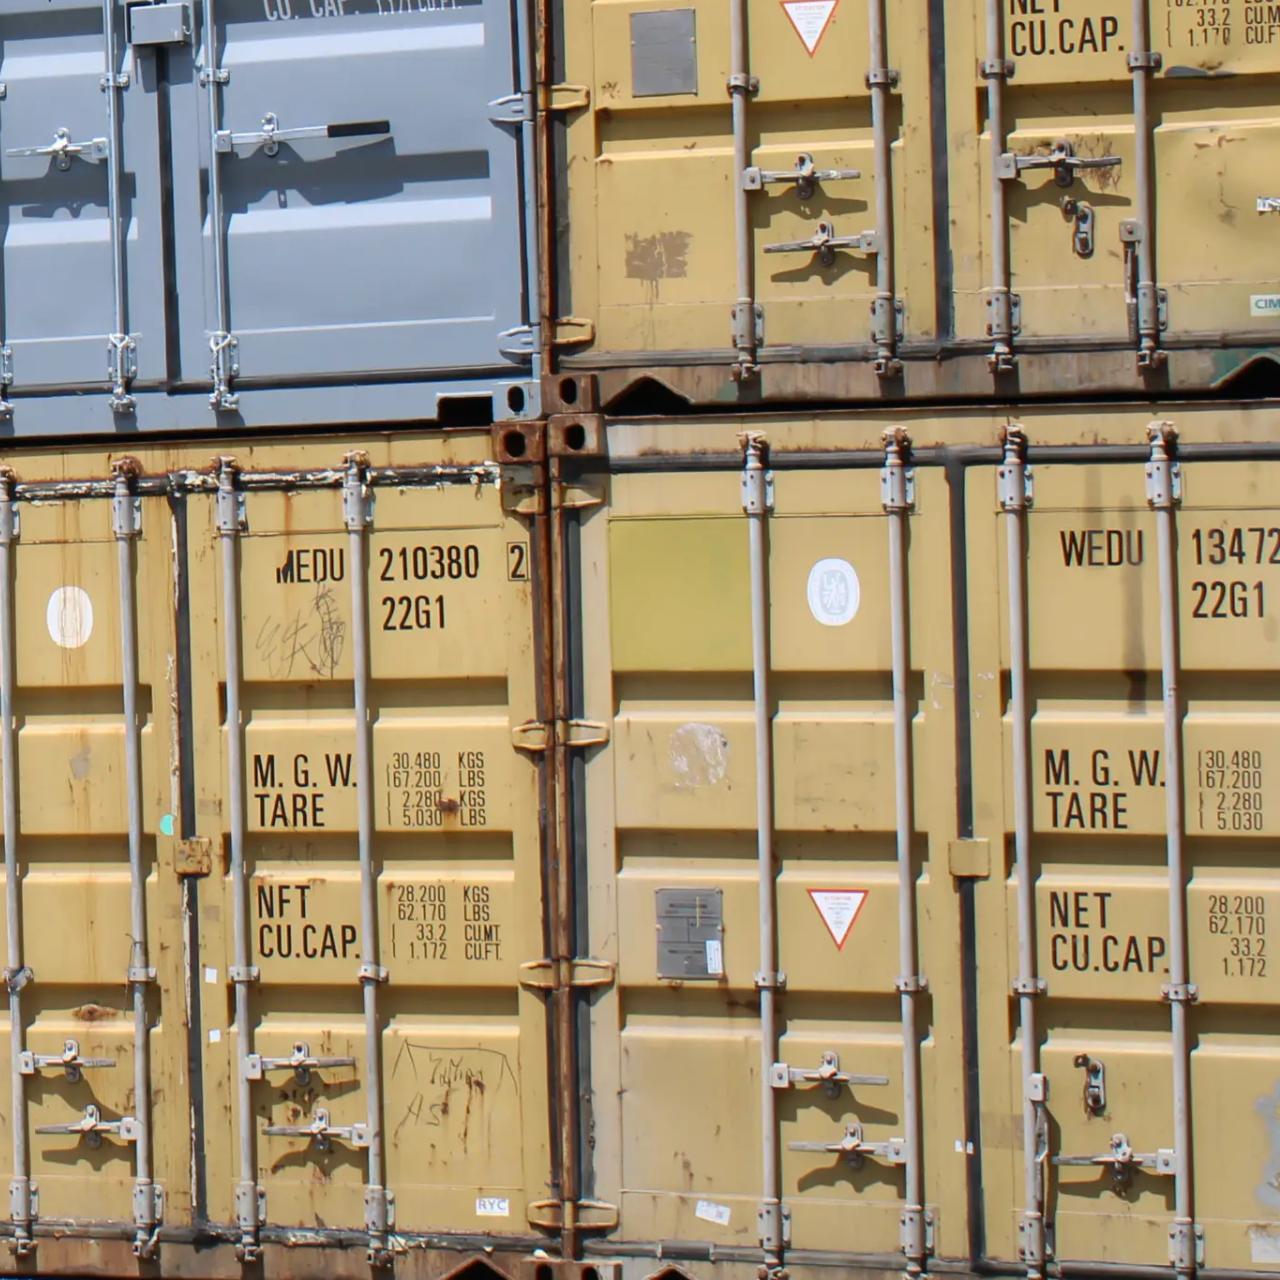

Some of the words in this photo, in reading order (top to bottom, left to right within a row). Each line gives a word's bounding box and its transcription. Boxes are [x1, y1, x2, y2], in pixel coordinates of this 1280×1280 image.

[1011, 16, 1125, 56] CU.CAP.
[380, 545, 479, 581] 210380
[509, 543, 526, 580] 2
[1191, 527, 1280, 565] 13472
[382, 595, 446, 631] 22G1
[1191, 581, 1265, 619] 22G1
[253, 754, 283, 788] M.
[294, 753, 317, 788] G.
[325, 753, 358, 788] W.
[458, 751, 484, 769] KGS
[1044, 749, 1080, 786] M.
[1092, 749, 1119, 787] G.
[1128, 750, 1166, 787] W.
[459, 770, 485, 788] LBS
[254, 793, 325, 827] TARE
[459, 790, 486, 808] KGS
[460, 808, 486, 826] LBS
[1045, 792, 1128, 829] TARE
[463, 885, 489, 903] KGS
[1050, 891, 1111, 929] NET
[464, 904, 490, 922] LBS
[258, 924, 360, 960] CU.CAP.
[1051, 934, 1170, 973] CU.CAP.
[477, 1199, 508, 1211] RYC
